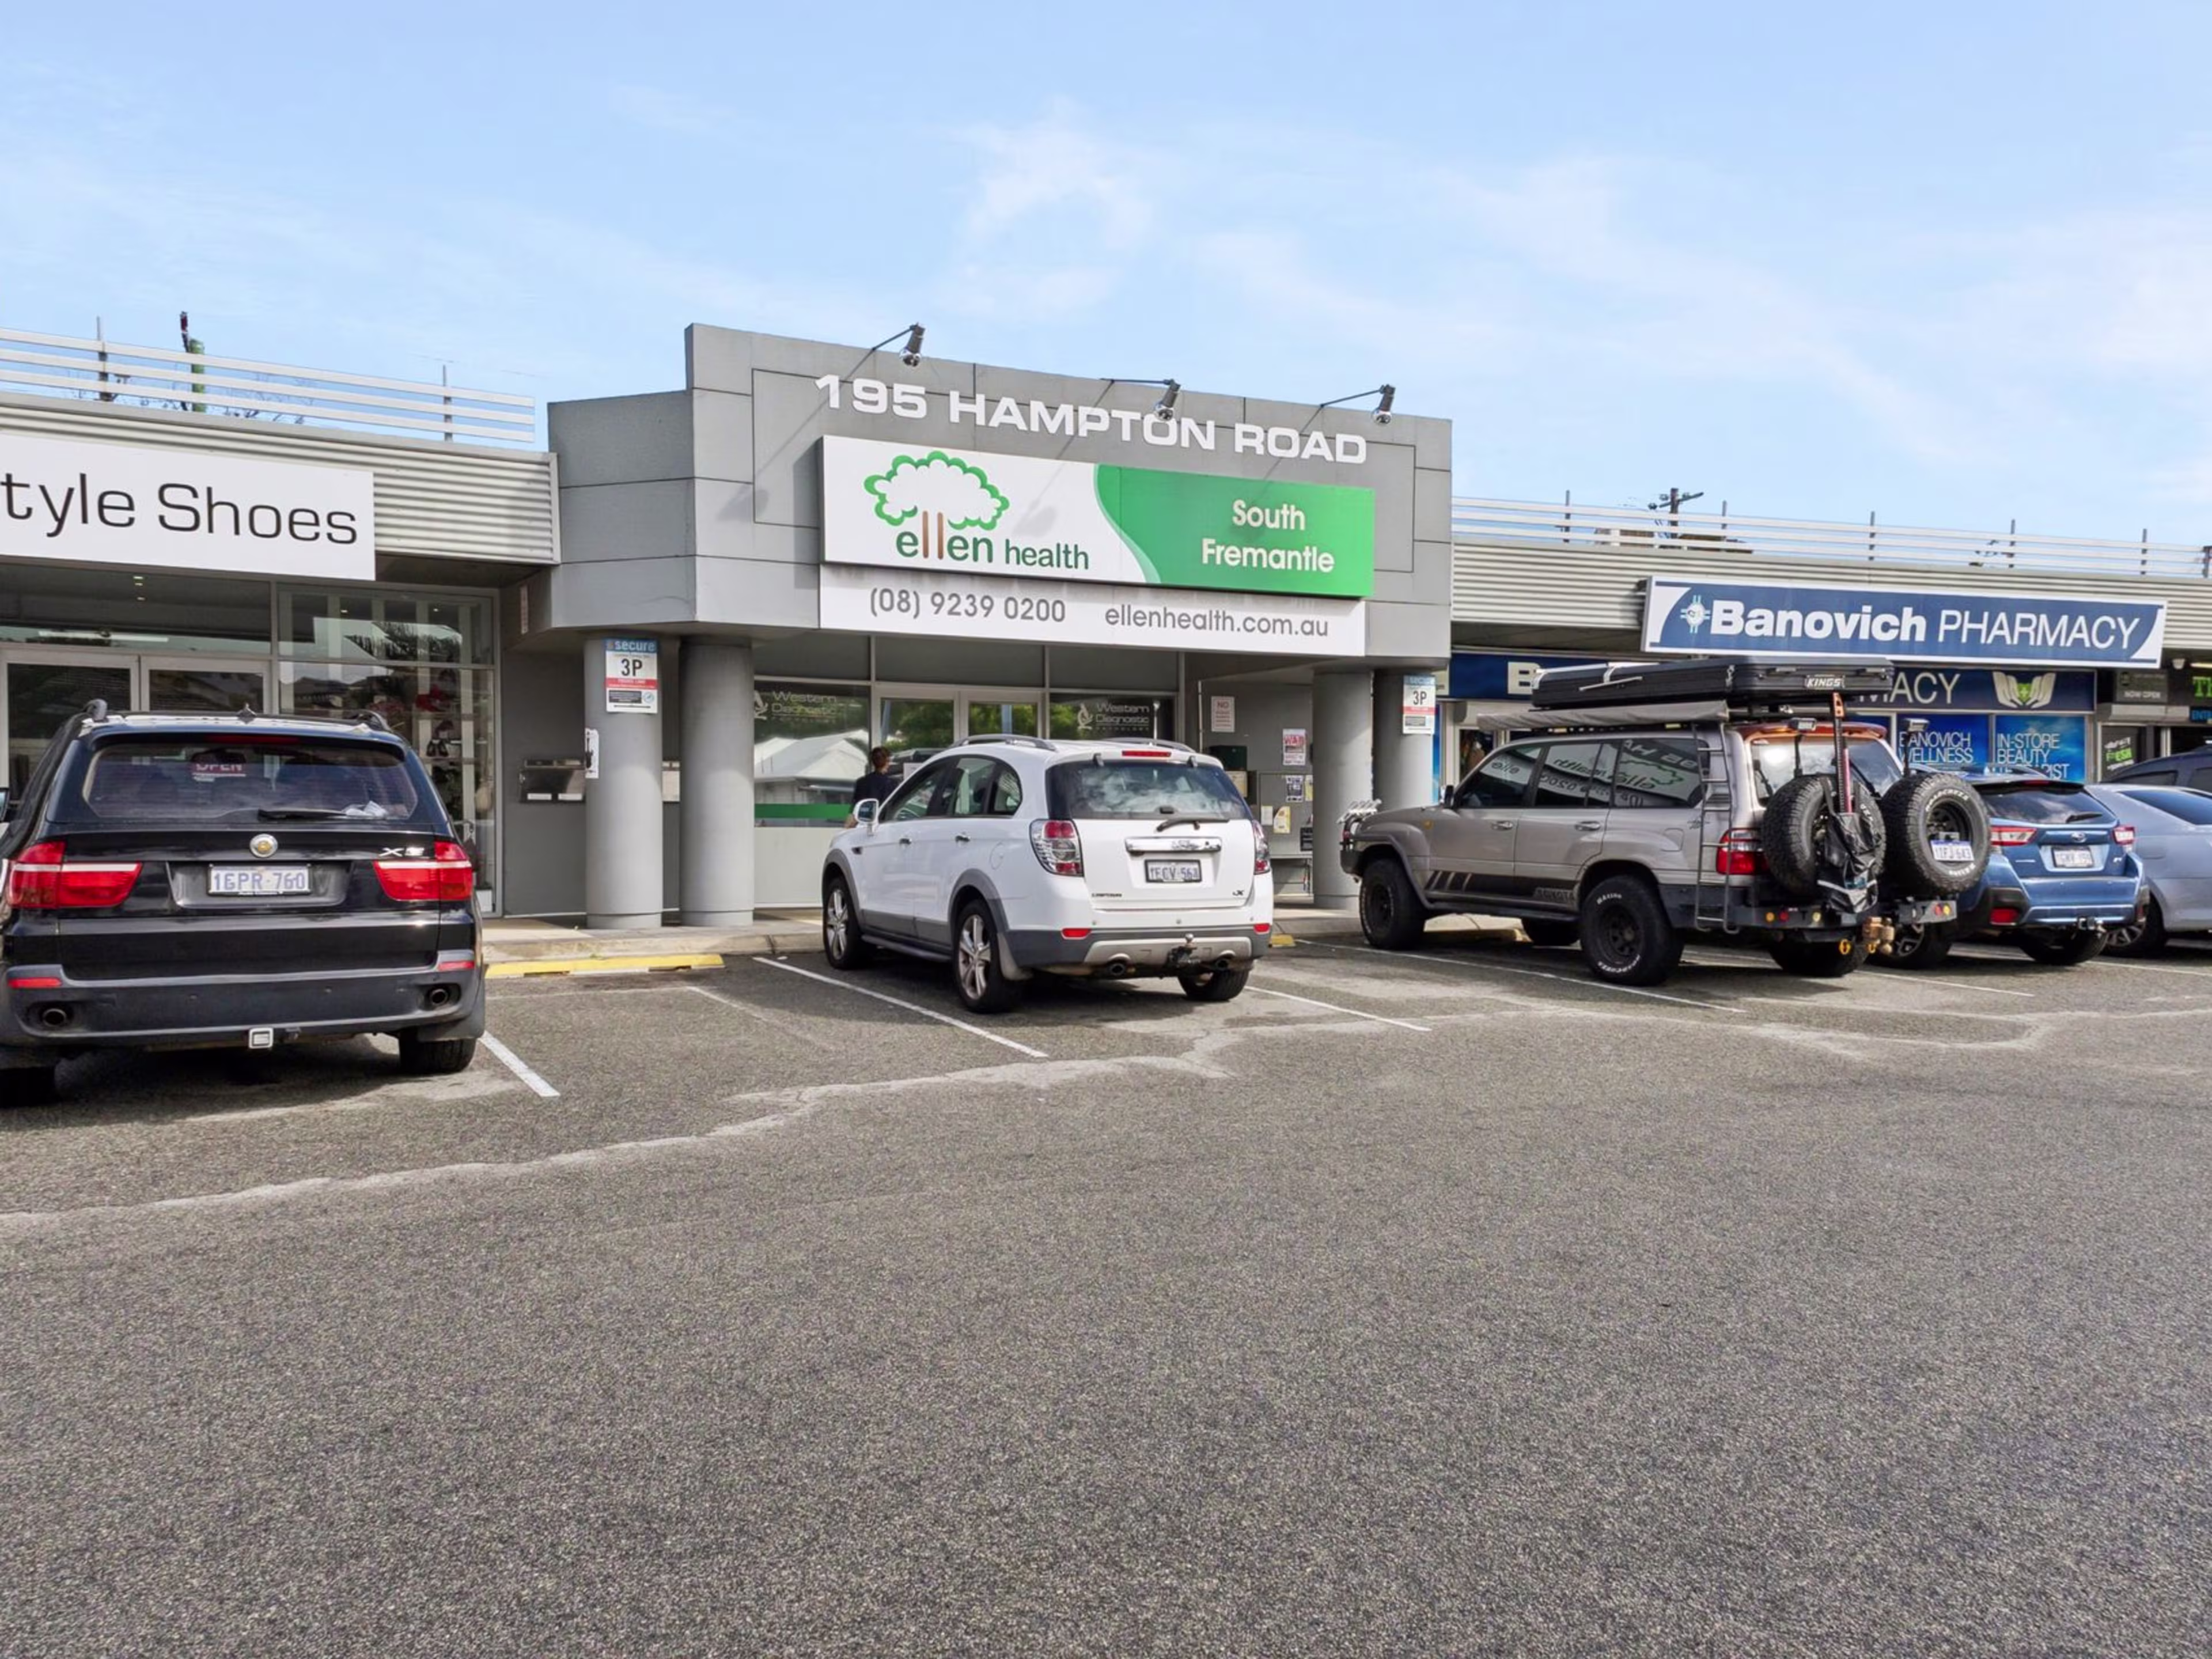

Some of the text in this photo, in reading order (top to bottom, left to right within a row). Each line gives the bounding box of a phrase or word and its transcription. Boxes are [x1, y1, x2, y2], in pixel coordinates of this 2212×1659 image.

[815, 374, 1367, 465] 195 HAMPTON ROAD
[157, 483, 358, 545] Shoes
[1232, 499, 1306, 531] South
[896, 510, 1089, 570] ellen health
[1201, 537, 1335, 573] Fremantle
[870, 587, 1066, 622] (08) 9239 0200
[1104, 604, 1329, 637] ellenhealth.com.au
[1710, 599, 2141, 649] Banovich PHARMACY
[621, 658, 642, 676] 3P
[1806, 677, 1842, 688] KINGS
[1096, 701, 1150, 713] Western
[1413, 690, 1427, 706] 3P
[1096, 714, 1149, 724] Diagnostic
[1997, 733, 2061, 749] IN-STORE
[1997, 748, 2050, 764] BEAUTY
